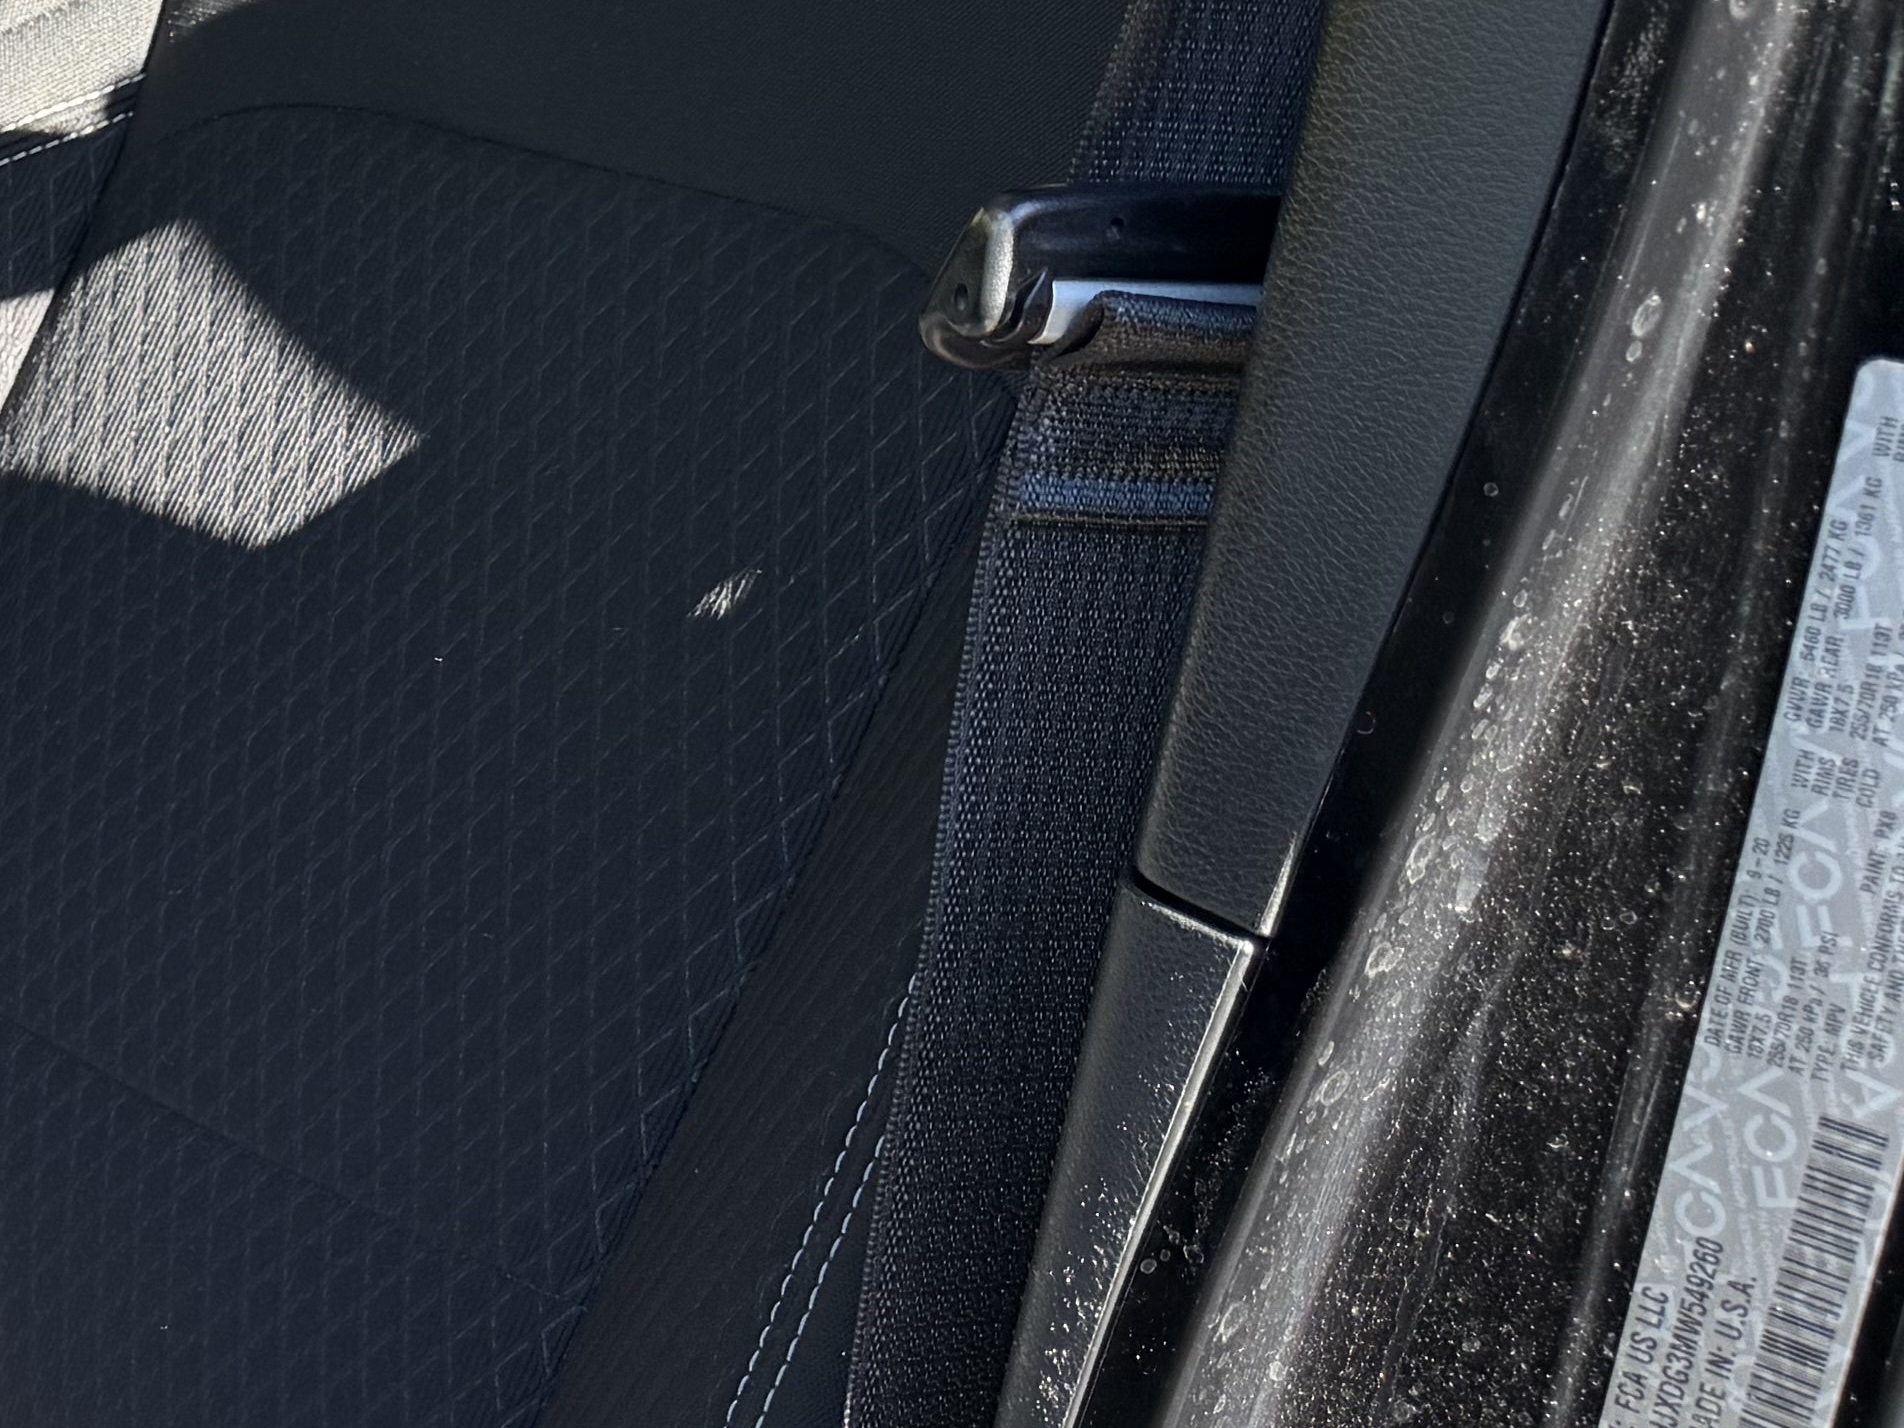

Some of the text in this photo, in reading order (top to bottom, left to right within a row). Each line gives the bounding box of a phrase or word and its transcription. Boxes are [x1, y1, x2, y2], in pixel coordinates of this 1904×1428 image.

[1871, 413, 1898, 461] WITH
[1862, 473, 1884, 500] KG
[1827, 516, 1848, 542] KG
[1853, 501, 1878, 540] 1361
[1818, 544, 1842, 583] 2477
[1842, 557, 1863, 581] LB
[1807, 600, 1827, 623] LB
[1832, 581, 1858, 623] 3000
[1868, 621, 1893, 659] 113T
[1805, 679, 1833, 730] GAWR
[1877, 691, 1900, 723] 250
[1870, 724, 1891, 748] AT
[1789, 746, 1816, 791] WITH
[1810, 753, 1837, 797] RIMS
[1831, 754, 1860, 803] TIRES
[1854, 765, 1882, 810] COLD
[1781, 806, 1800, 830] KG
[1771, 830, 1795, 868] 1225
[1890, 863, 1904, 886] TO
[1762, 885, 1781, 907] LB
[1752, 907, 1776, 945] 2700
[1818, 928, 1839, 957] PSI
[1866, 887, 1904, 973] CONFORMS
[1719, 947, 1742, 983] MFR
[1784, 956, 1807, 991] 113T
[1813, 957, 1832, 979] 36
[1713, 982, 1734, 1007] OF
[1849, 973, 1881, 1037] VEHICLE
[1703, 1006, 1728, 1048] DATE
[1724, 1007, 1751, 1055] GAWR
[1822, 1001, 1847, 1038] MPV
[1866, 1003, 1897, 1063] SAFETY
[1883, 968, 1904, 1002] AND
[1794, 1024, 1815, 1054] 250
[1839, 1037, 1864, 1075] THIS
[1788, 1055, 1807, 1077] AT
[1634, 1283, 1669, 1330] LLC
[1713, 1266, 1757, 1343] U.S.A.
[1625, 1329, 1657, 1366] US
[1704, 1342, 1737, 1381] IN:
[1613, 1366, 1648, 1415] FCA
